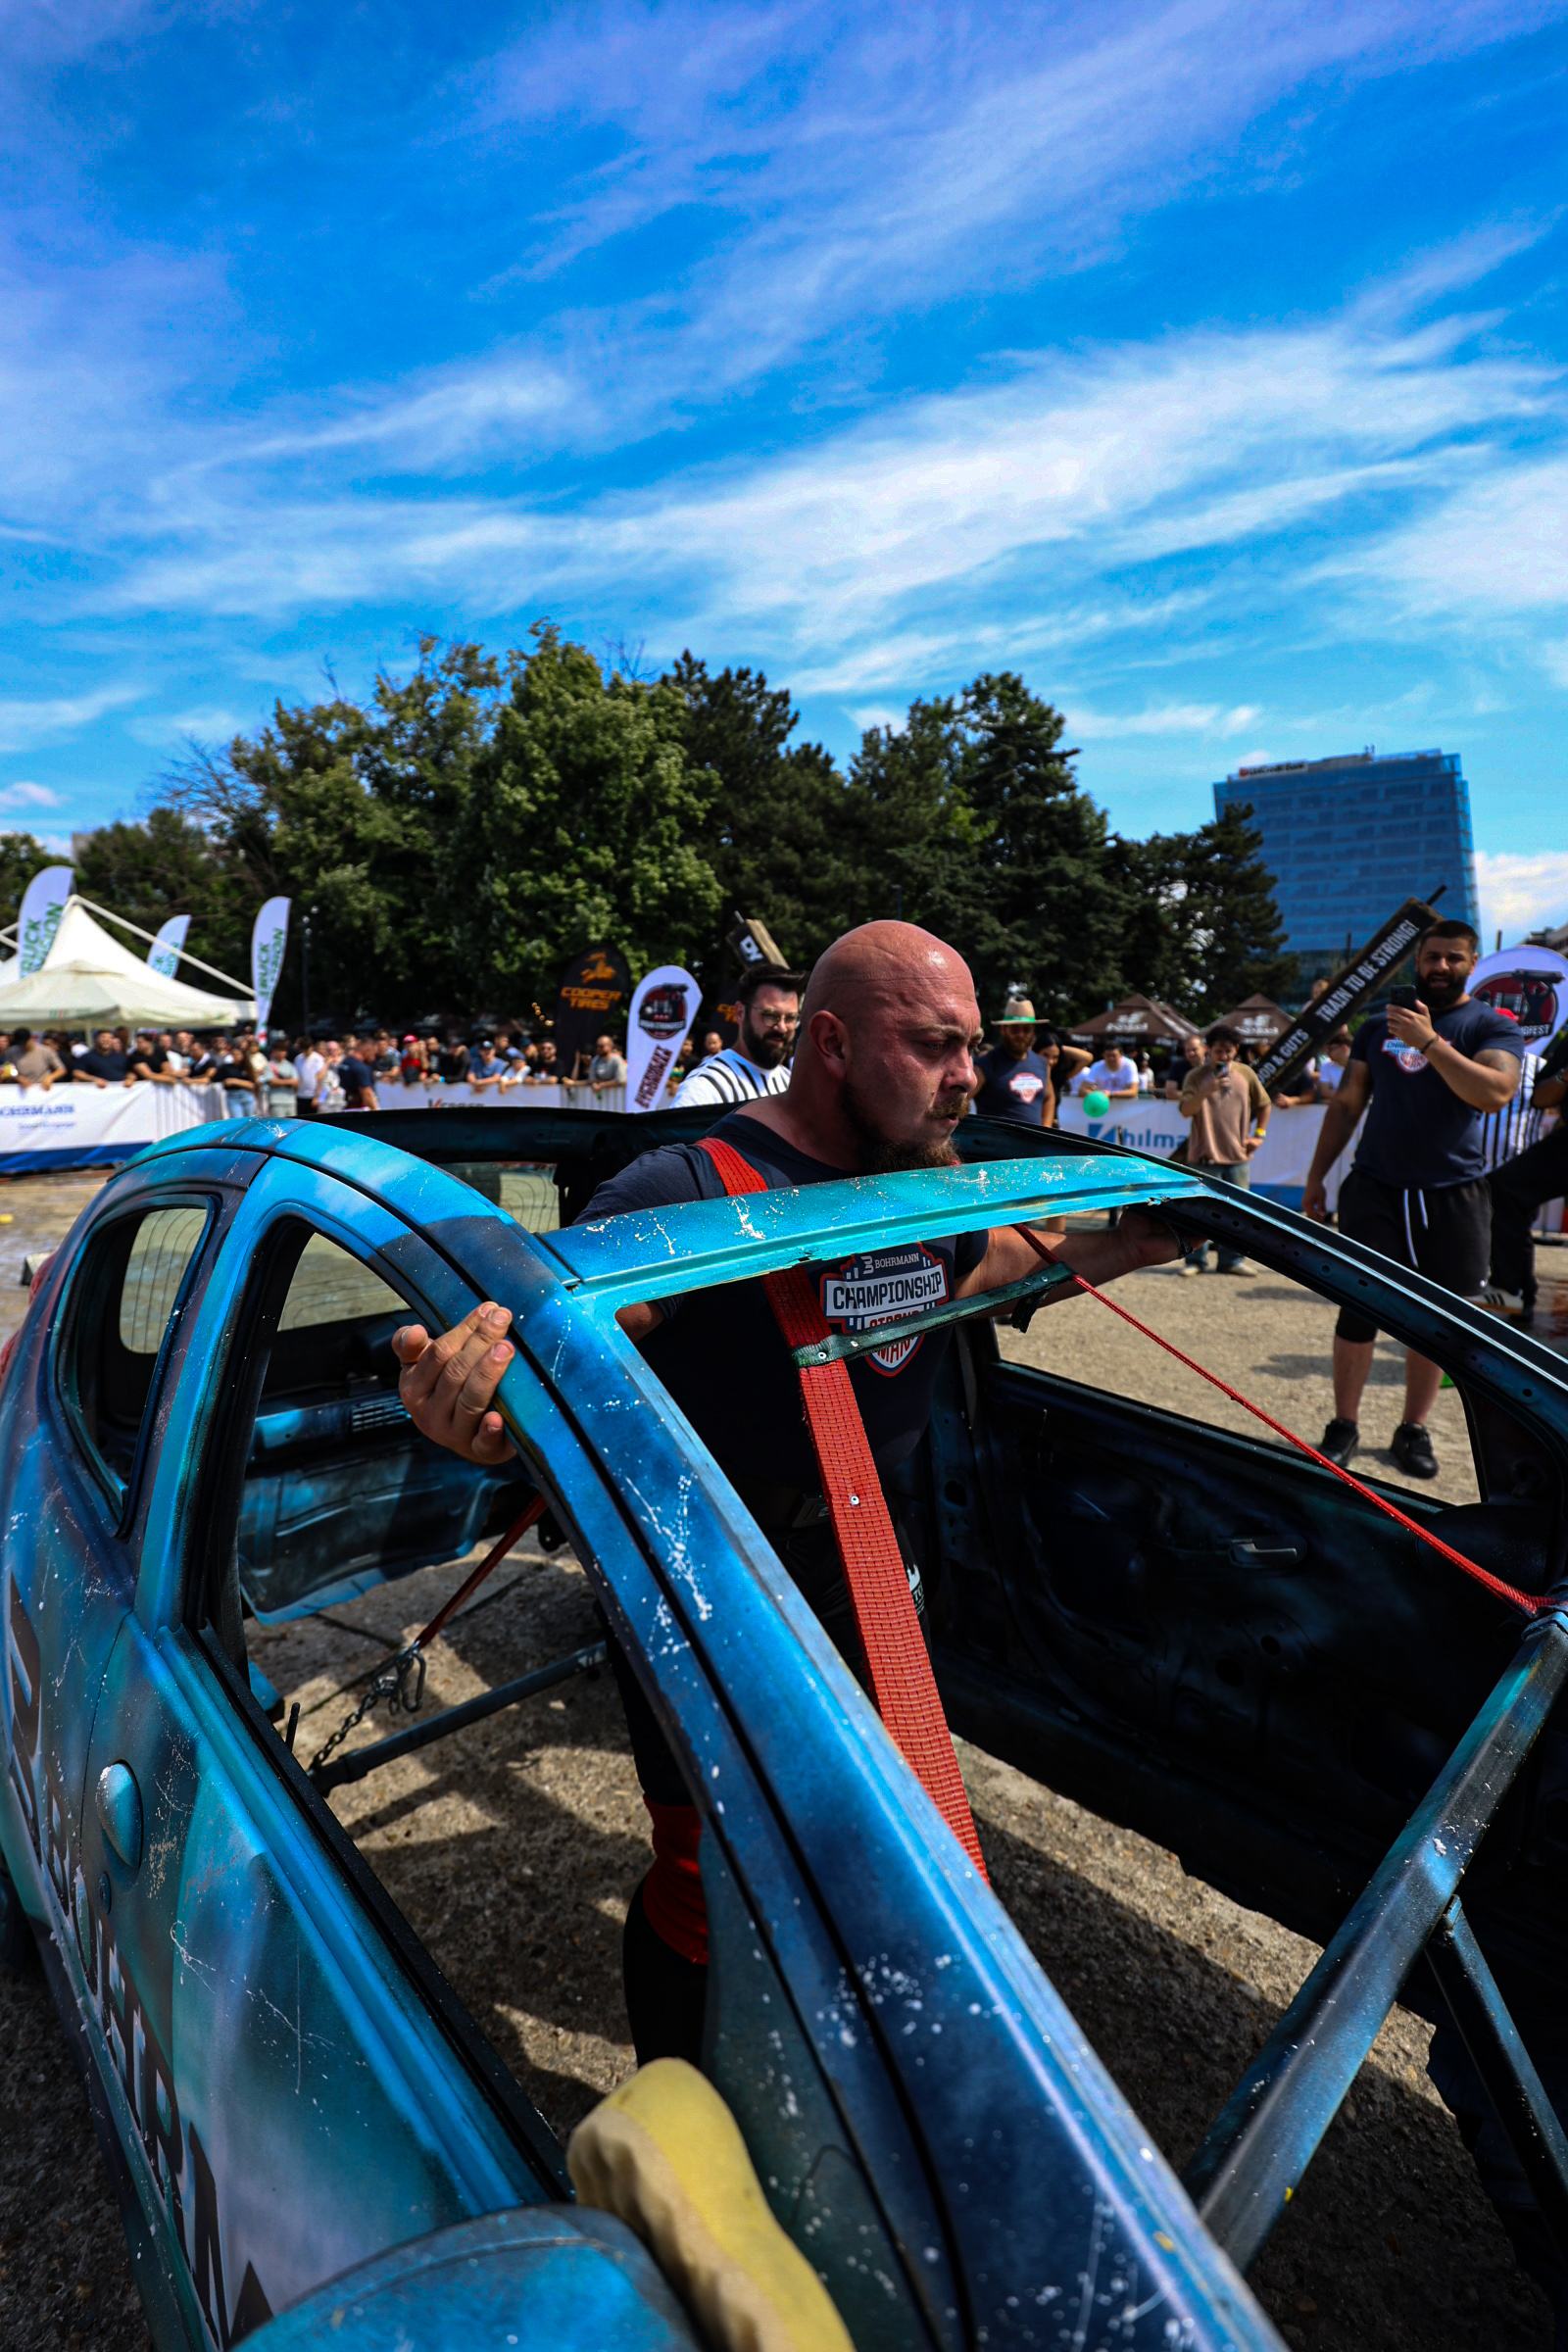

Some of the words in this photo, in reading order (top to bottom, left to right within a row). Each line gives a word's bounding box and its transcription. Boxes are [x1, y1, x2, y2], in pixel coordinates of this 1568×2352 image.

[1315, 986, 1353, 1022] TRAIN
[1343, 974, 1366, 993] TO
[1355, 959, 1380, 981] BE
[1370, 919, 1420, 967] STRONG!
[1279, 1028, 1309, 1057] GUTS
[874, 1252, 919, 1269] BOHRMANN
[832, 1271, 942, 1310] CHAMPIONSHIP
